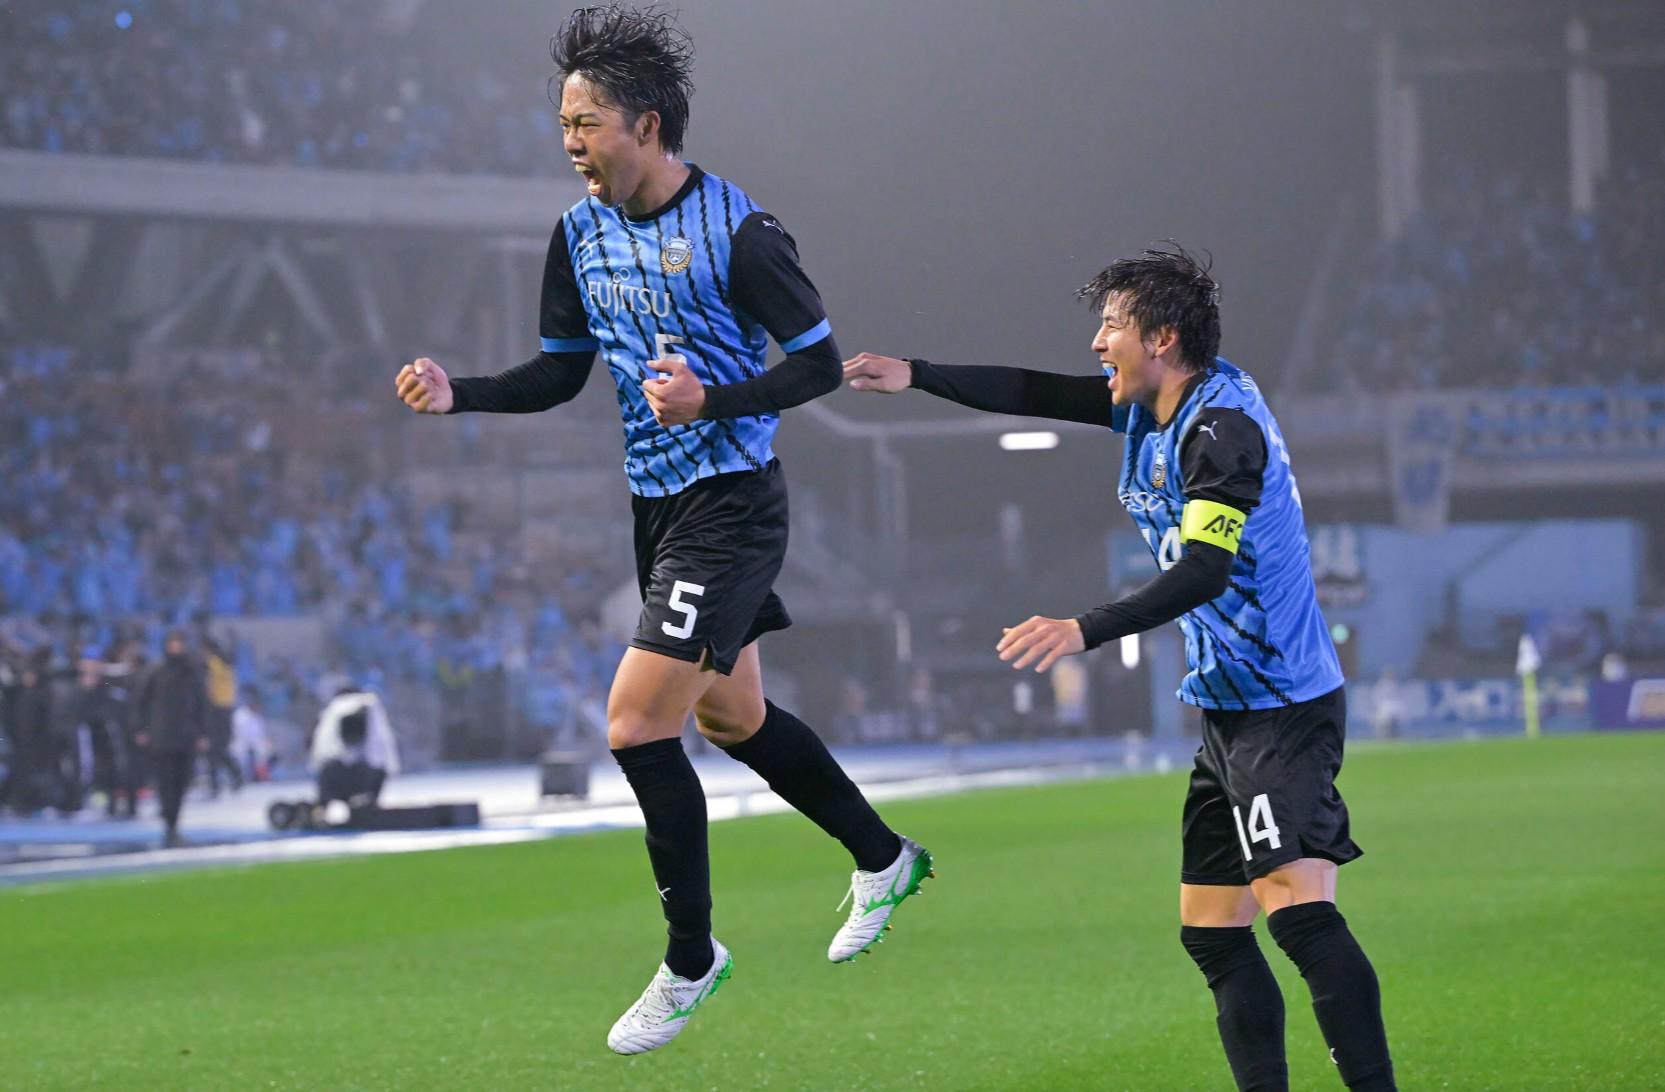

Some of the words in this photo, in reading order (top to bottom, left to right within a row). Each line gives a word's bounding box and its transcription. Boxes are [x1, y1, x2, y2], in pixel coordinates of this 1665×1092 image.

[588, 280, 670, 317] FUJITSU
[655, 333, 687, 381] 5
[661, 579, 705, 639] 5
[1232, 793, 1282, 861] 14
